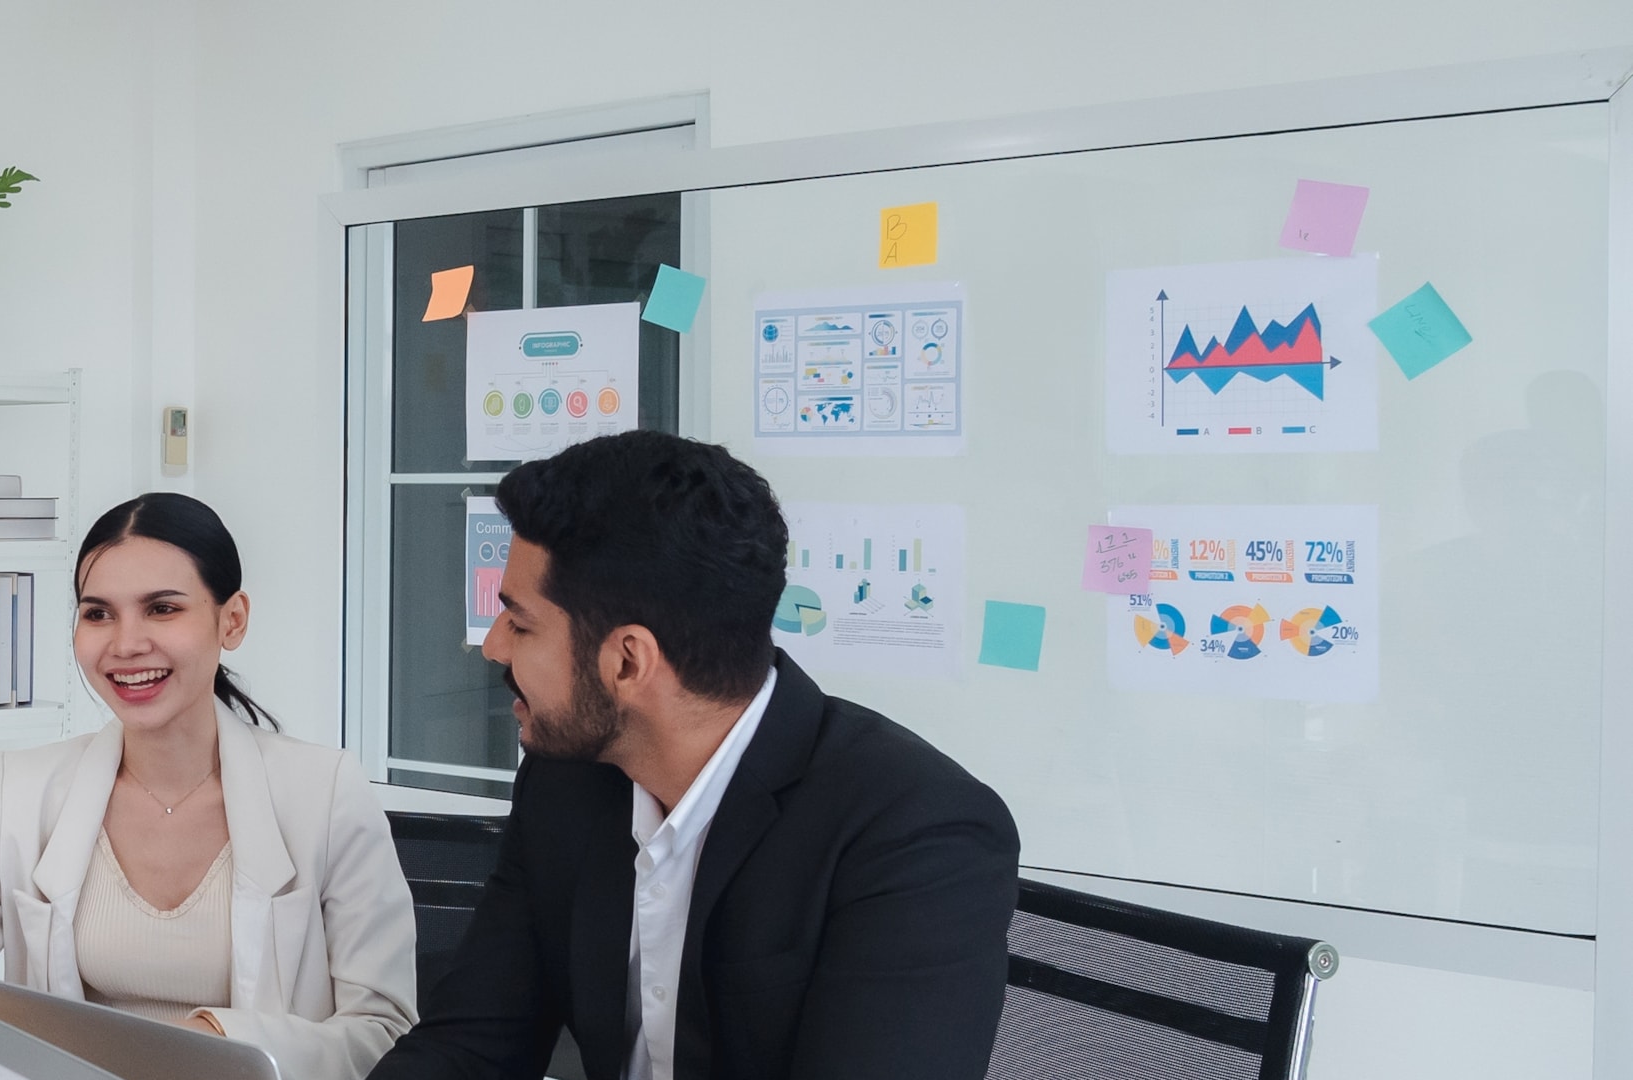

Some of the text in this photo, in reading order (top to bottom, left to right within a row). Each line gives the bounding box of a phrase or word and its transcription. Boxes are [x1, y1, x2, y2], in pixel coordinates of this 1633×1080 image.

[886, 214, 908, 241] B
[883, 241, 899, 265] A
[1203, 428, 1210, 436] A
[1256, 427, 1263, 435] B
[1309, 425, 1317, 434] C
[1189, 540, 1225, 561] 12%
[1245, 540, 1283, 562] 45%
[1305, 541, 1343, 563] 72%
[1346, 541, 1355, 573] INVESTMENT
[1129, 594, 1153, 607] 51%
[1331, 626, 1359, 641] 20%
[1200, 639, 1226, 654] 34%
